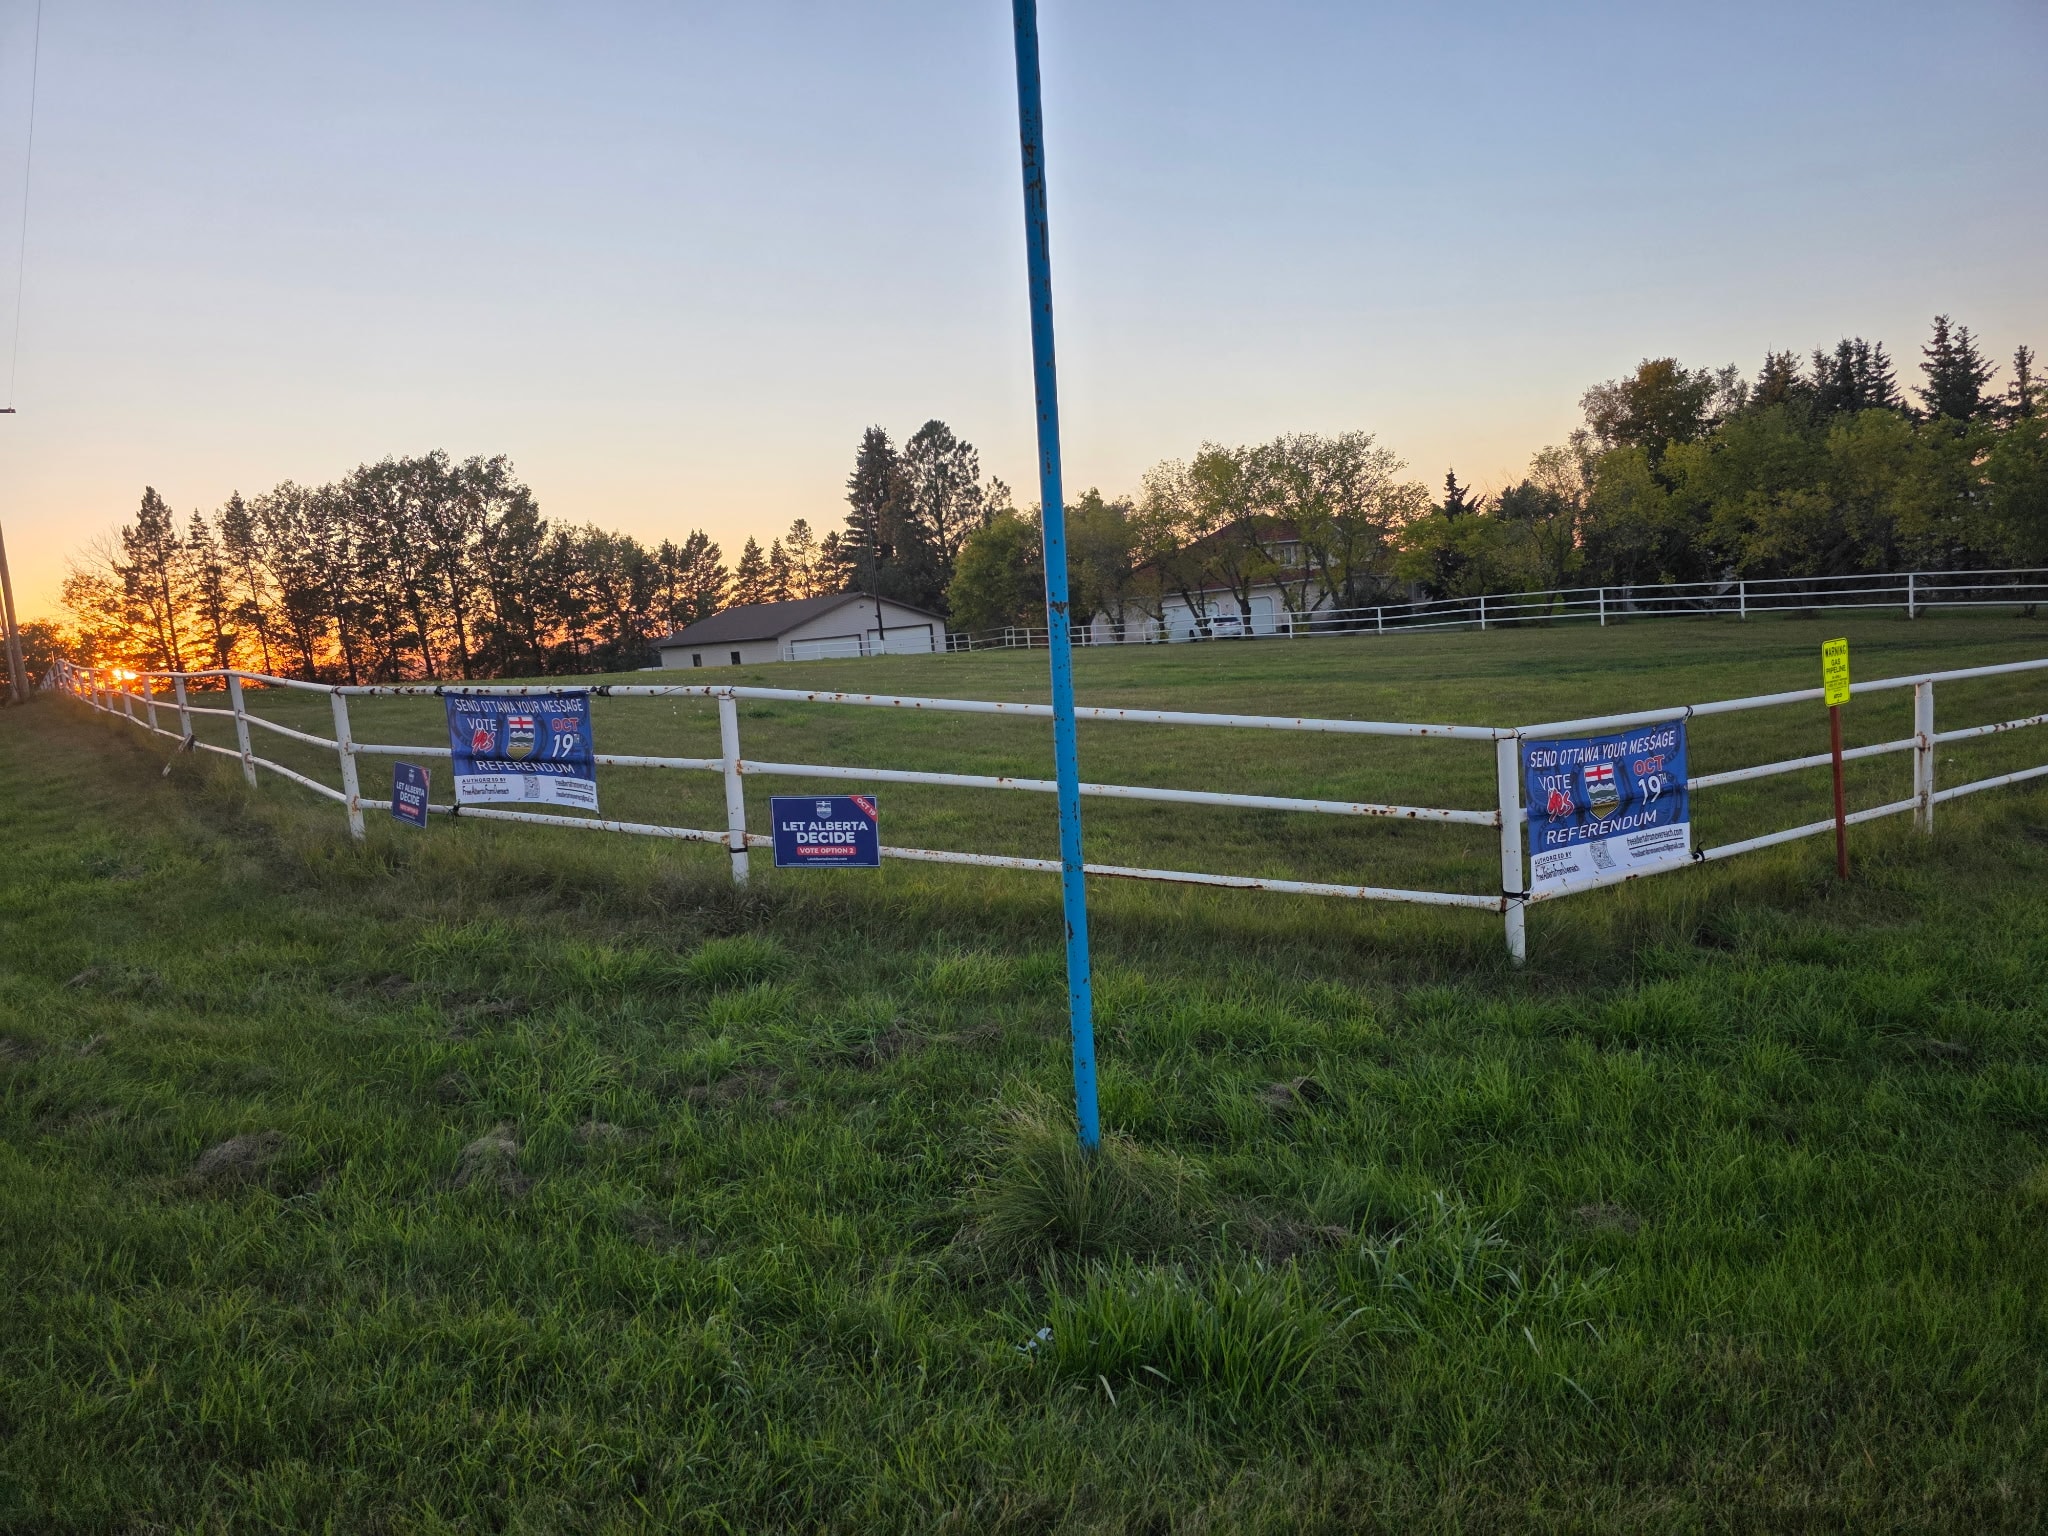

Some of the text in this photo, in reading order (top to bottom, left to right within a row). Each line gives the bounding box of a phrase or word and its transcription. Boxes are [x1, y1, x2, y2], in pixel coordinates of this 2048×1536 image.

[1825, 645, 1846, 657] WARNING
[1831, 658, 1840, 666] GAS
[1826, 665, 1846, 673] PIPELINE
[455, 699, 583, 713] SEND OTTAWA YOUR MESSAGE
[467, 718, 497, 731] VOTE
[552, 718, 578, 732] OCT
[1531, 731, 1674, 768] SEND OTTAWA YOUR MESSAGE
[476, 761, 575, 773] REFERENDUM
[1634, 755, 1664, 776] OCT
[1538, 774, 1571, 791] VOTE
[405, 783, 424, 797] ALBERTA
[400, 792, 419, 805] DECIDE
[857, 798, 869, 809] OCT
[783, 821, 868, 831] LET ALBERTA
[1547, 810, 1656, 844] REFERENDUM
[797, 832, 855, 843] DECIDE
